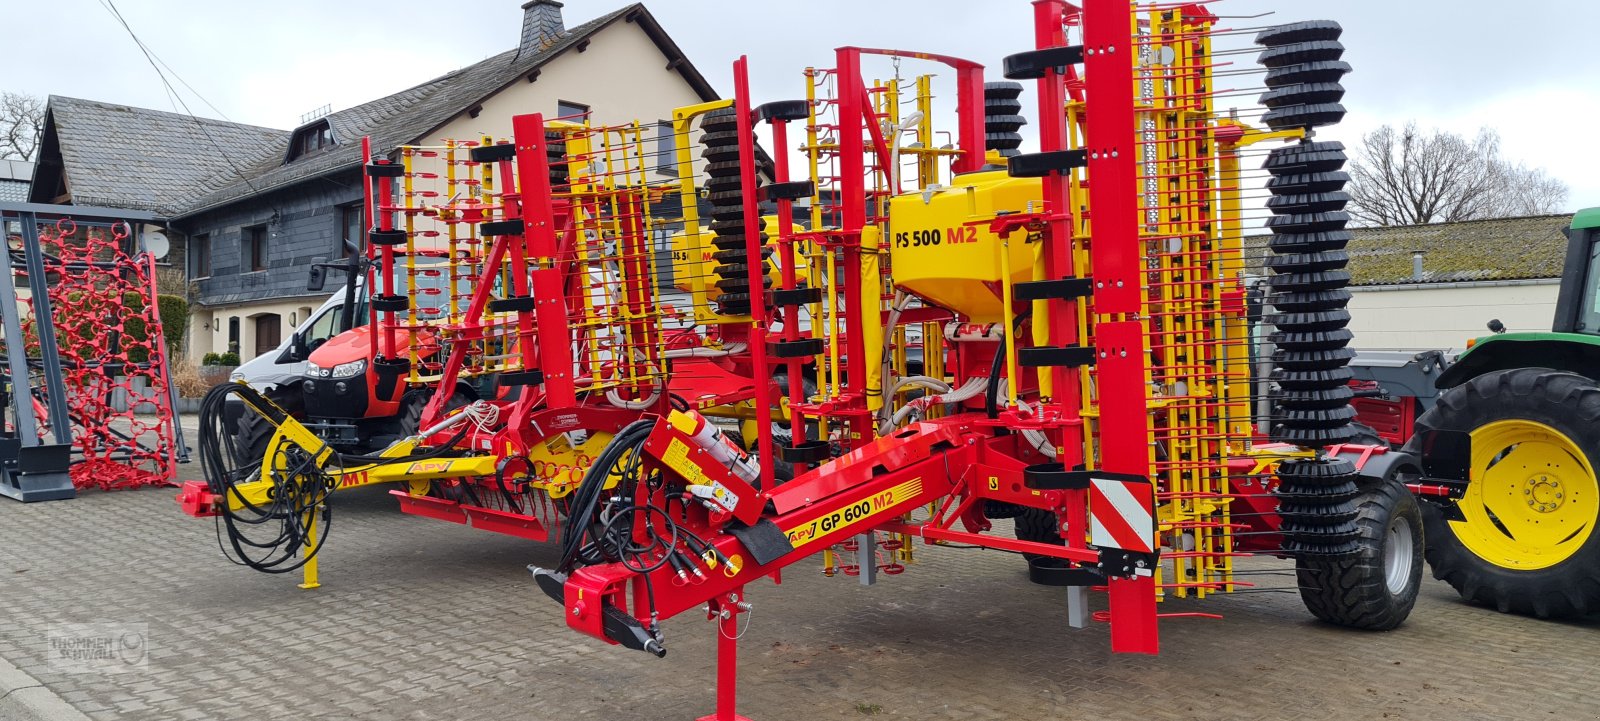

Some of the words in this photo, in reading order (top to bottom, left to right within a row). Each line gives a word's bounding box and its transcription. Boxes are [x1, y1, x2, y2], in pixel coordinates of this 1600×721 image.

[896, 232, 909, 248] PS
[913, 229, 941, 247] 500
[947, 227, 978, 245] M2
[956, 323, 990, 336] APV
[410, 462, 449, 472] APV
[342, 471, 369, 487] M1
[790, 525, 814, 543] APV
[821, 513, 841, 532] GP
[844, 501, 871, 523] 600
[873, 491, 894, 511] M2
